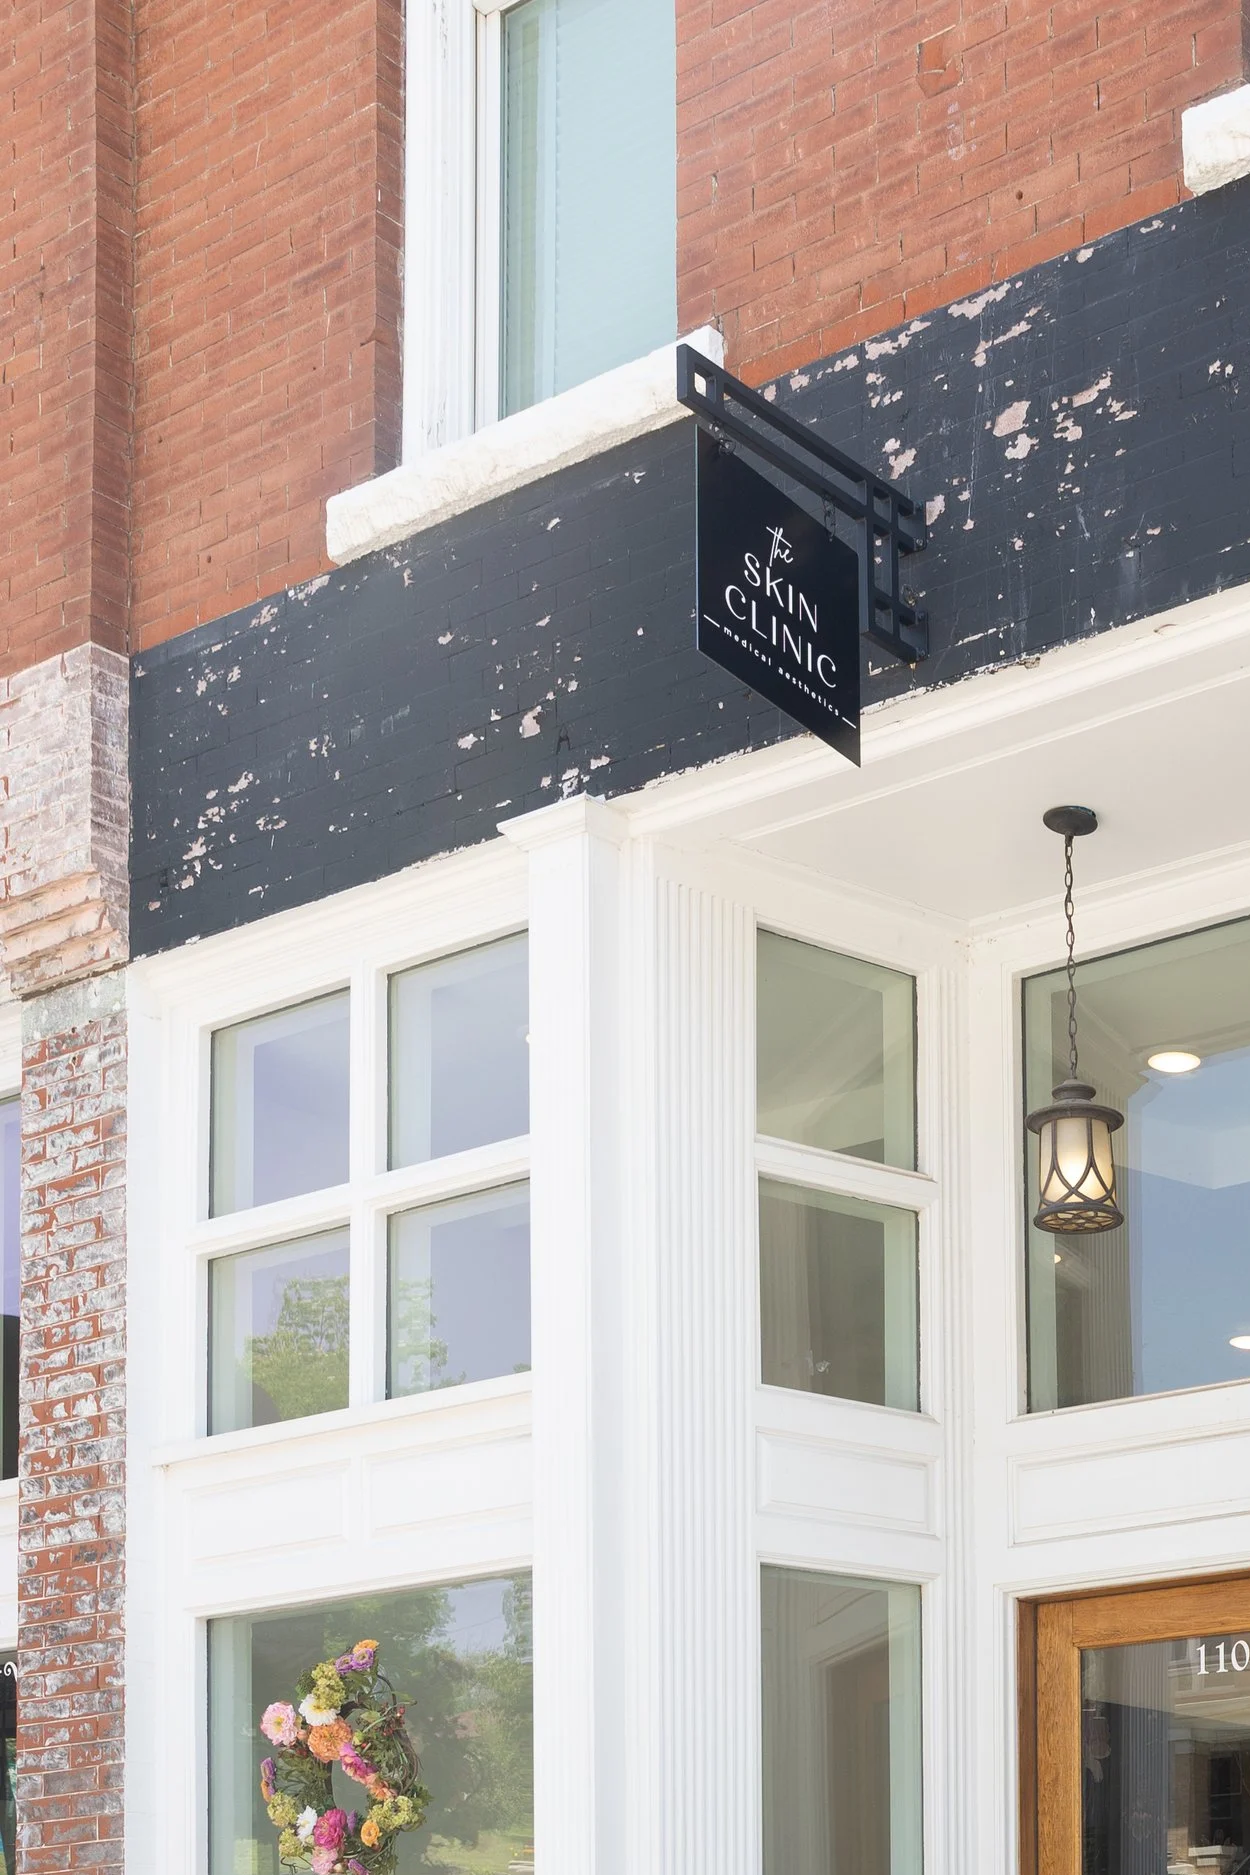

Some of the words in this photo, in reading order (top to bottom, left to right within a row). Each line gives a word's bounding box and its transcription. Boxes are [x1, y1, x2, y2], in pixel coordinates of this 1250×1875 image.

[766, 526, 793, 567] the
[743, 552, 818, 633] SKIN
[724, 627, 772, 666] medical
[778, 667, 839, 716] aesthetics
[725, 585, 837, 688] CLINIC
[1196, 1640, 1250, 1676] 110
